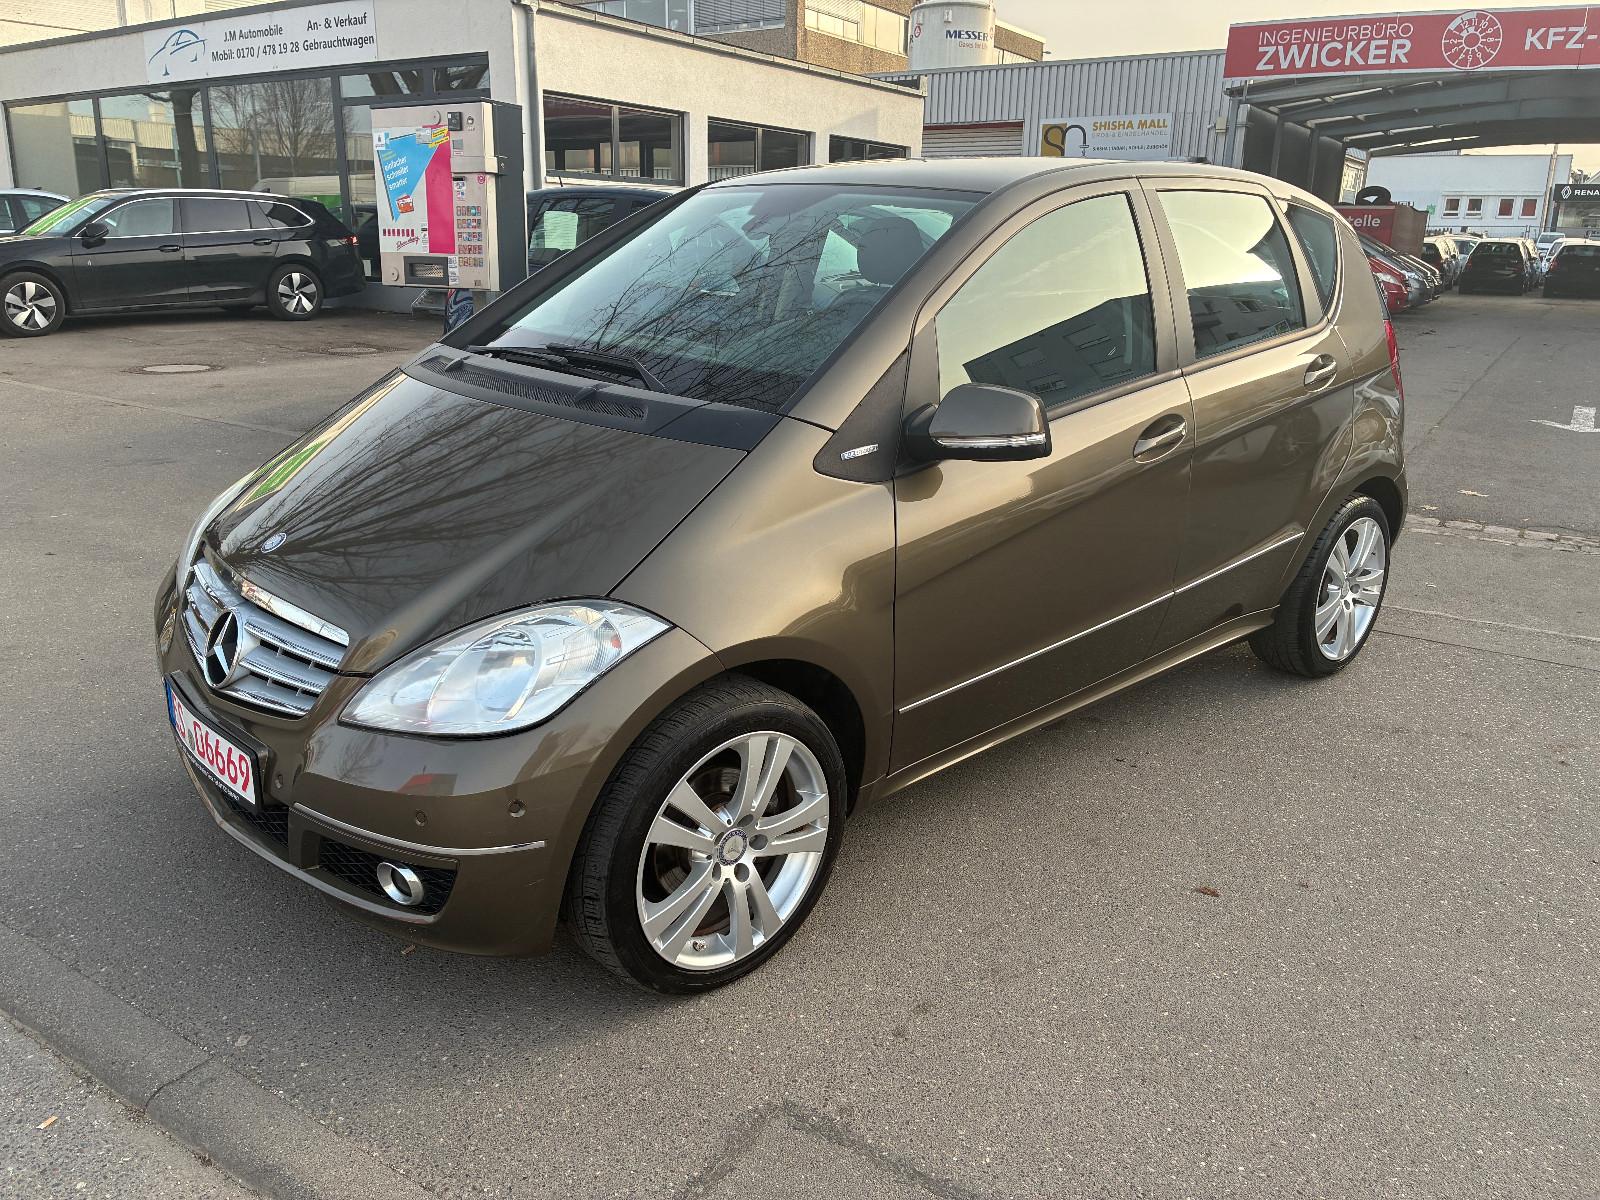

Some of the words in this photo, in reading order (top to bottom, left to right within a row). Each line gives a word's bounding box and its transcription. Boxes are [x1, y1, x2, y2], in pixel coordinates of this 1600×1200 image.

[306, 19, 322, 32] An-
[324, 16, 332, 29] &
[334, 12, 368, 28] Verkauf
[1460, 20, 1468, 29] 12
[1472, 18, 1478, 26] 11
[1479, 20, 1488, 29] 10
[224, 30, 237, 42] J.M
[238, 24, 283, 41] Automobile
[945, 29, 988, 41] MESSER
[1258, 22, 1414, 46] INGENIEURBÜRO
[1524, 26, 1598, 51] KFZ-
[211, 48, 235, 62] Mobil:
[236, 46, 255, 60] 0170
[256, 46, 261, 59] /
[262, 44, 277, 56] 478
[278, 42, 288, 54] 19
[290, 41, 300, 53] 28
[302, 34, 375, 52] Gebrauchtwagen
[1256, 39, 1412, 70] ZWICKER
[1092, 121, 1134, 131] SHISHA
[1136, 118, 1168, 130] MALL
[193, 720, 251, 793] 06669
